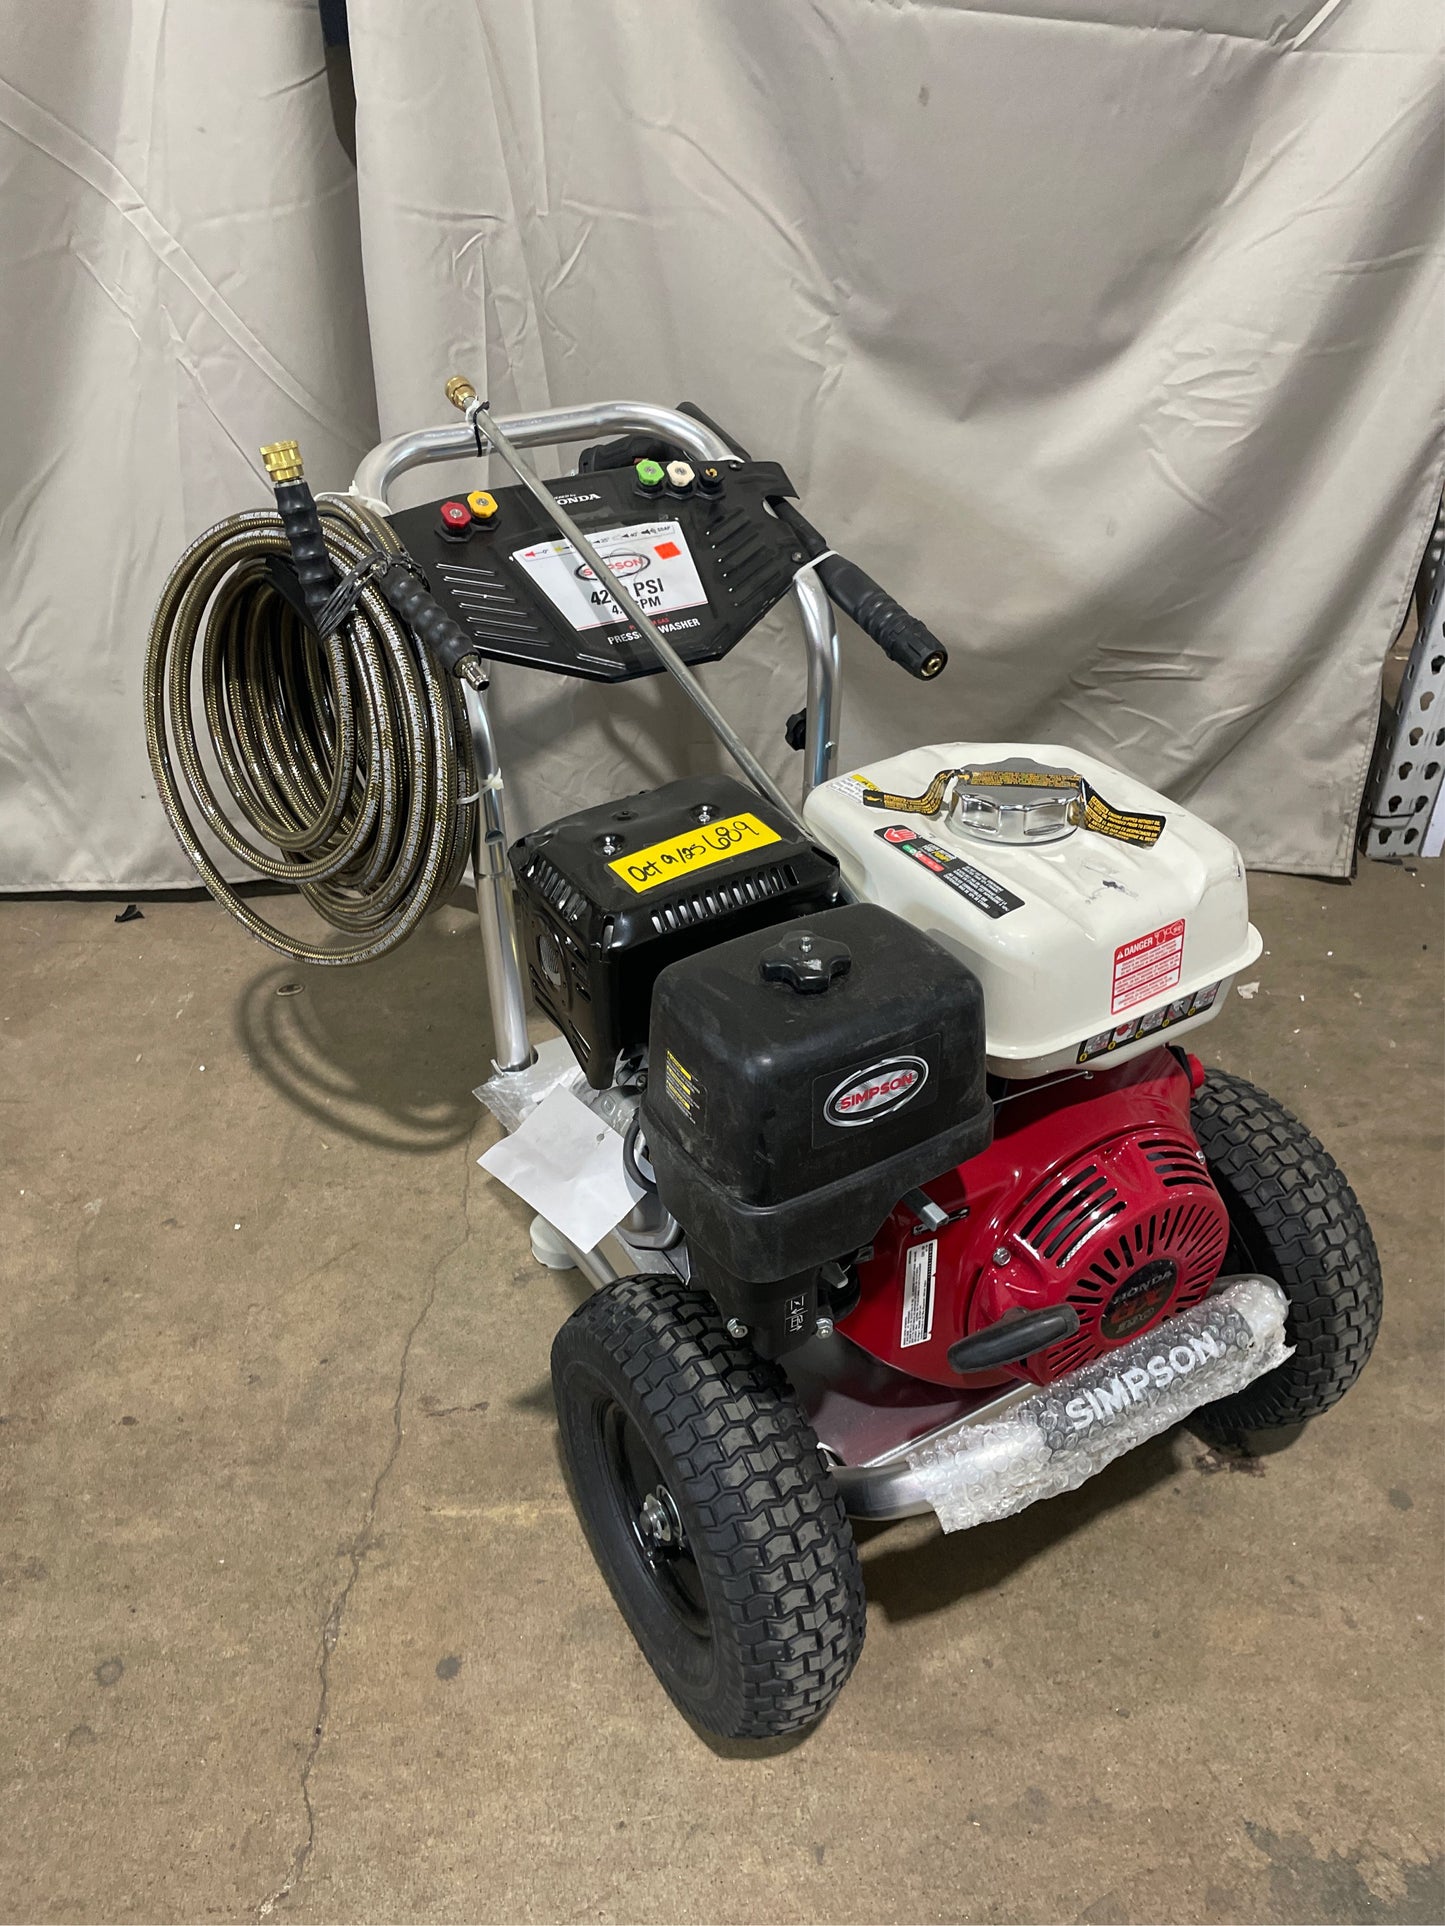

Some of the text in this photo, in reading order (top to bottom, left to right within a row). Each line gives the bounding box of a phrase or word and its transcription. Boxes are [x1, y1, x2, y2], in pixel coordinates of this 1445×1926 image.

[557, 494, 601, 505] ONDA
[633, 578, 664, 597] PSI
[607, 631, 642, 645] PRESS
[658, 618, 701, 634] WASHER
[628, 860, 662, 881] Oct
[702, 821, 759, 850] 689
[1124, 937, 1153, 957] DANGER
[840, 1072, 913, 1110] SIMPSON
[1113, 1270, 1173, 1304] HONDA
[1066, 1331, 1220, 1430] SIMPSON
